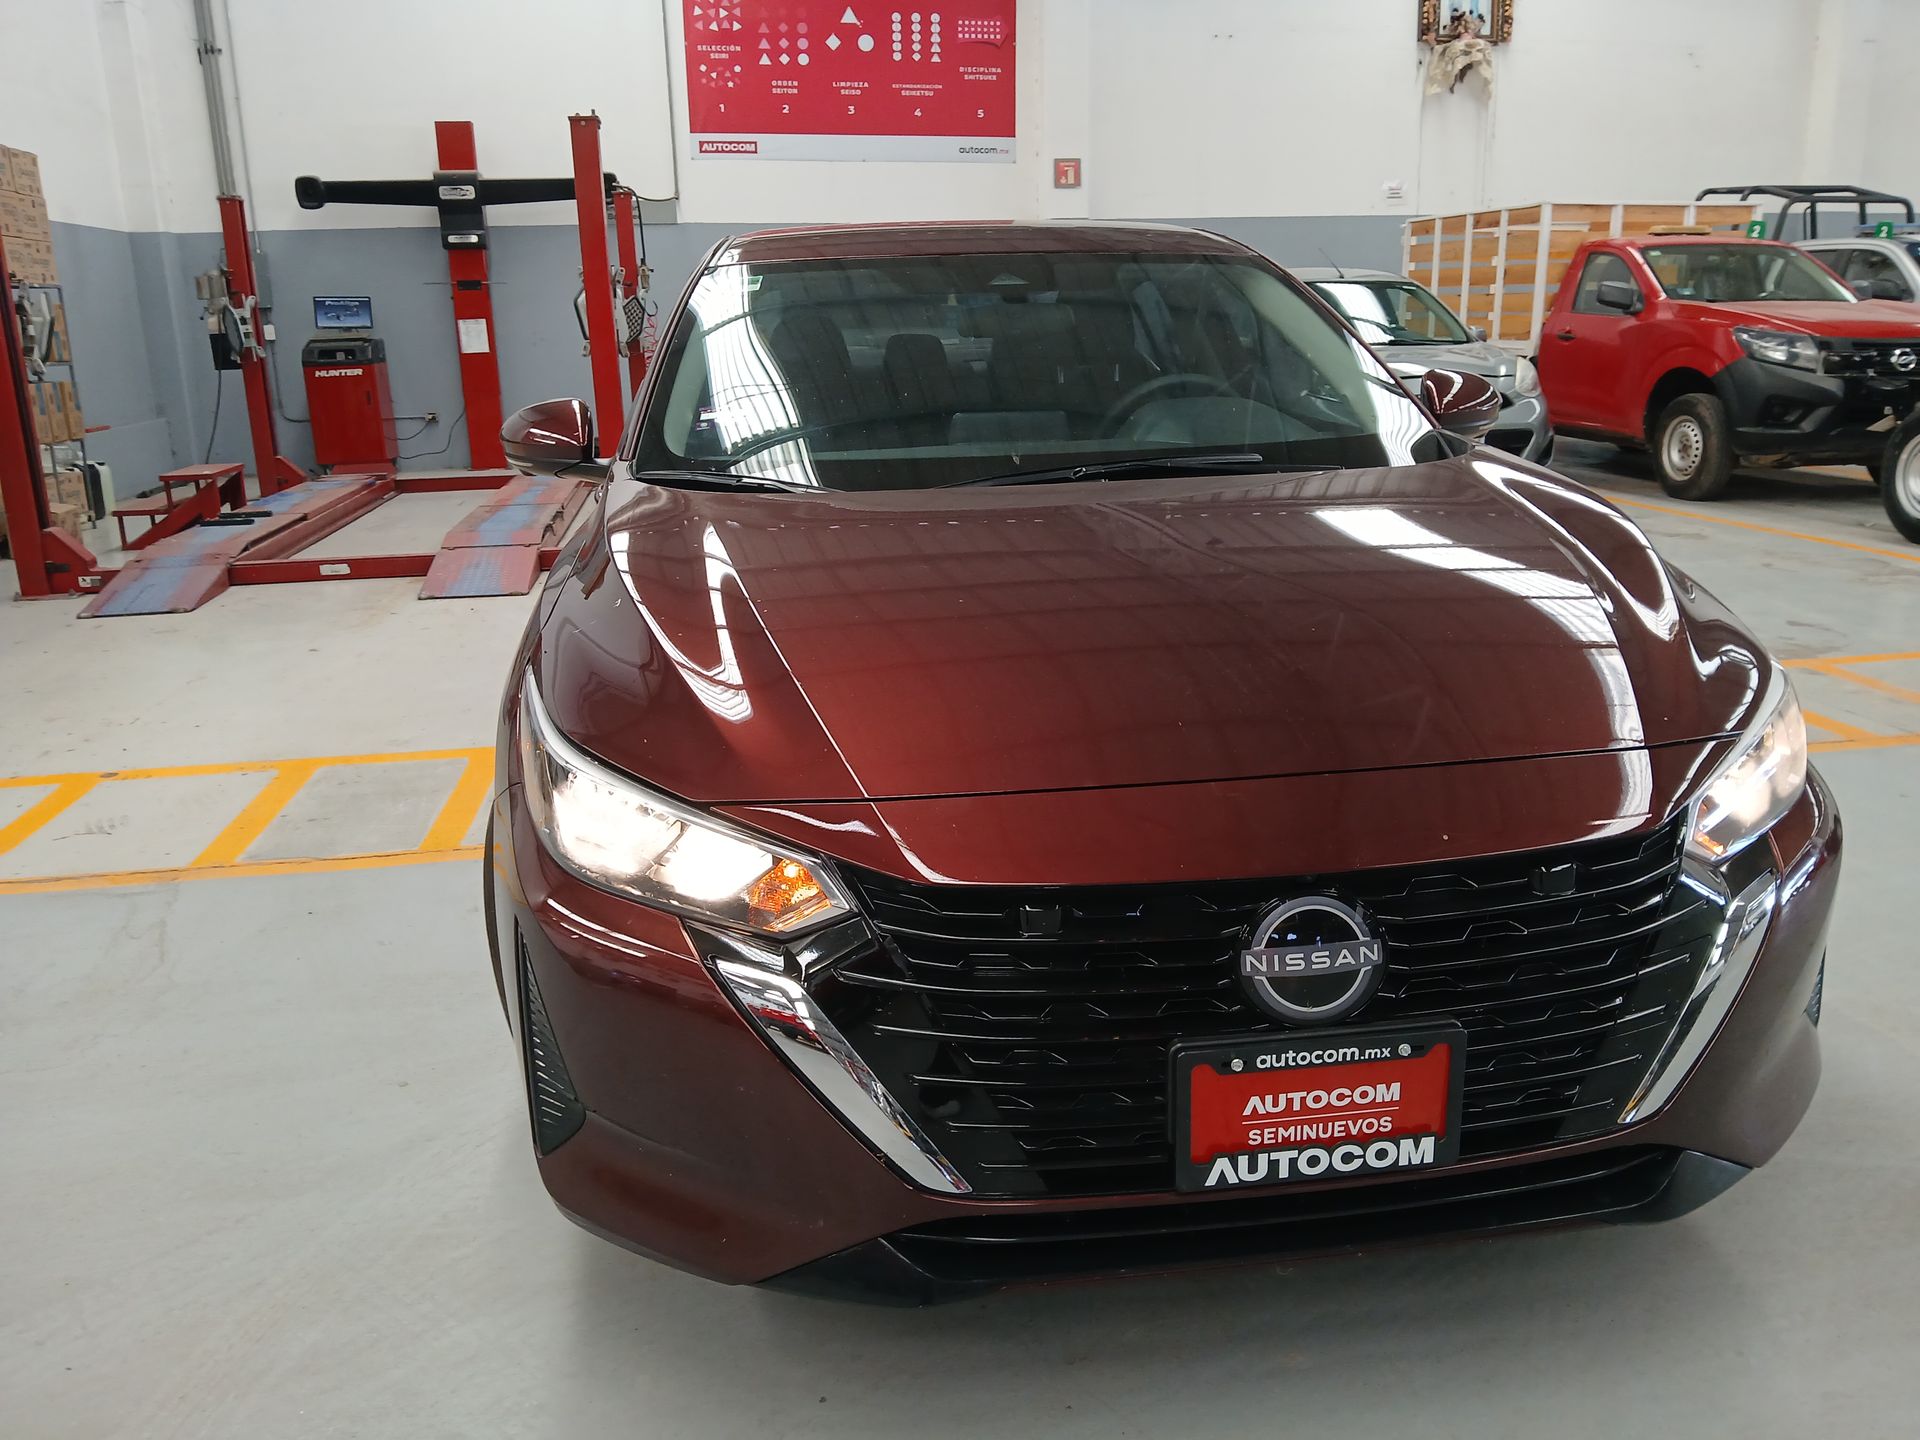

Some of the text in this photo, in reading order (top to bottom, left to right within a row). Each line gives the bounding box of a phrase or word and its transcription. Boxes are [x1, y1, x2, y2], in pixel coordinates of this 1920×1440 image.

[719, 103, 725, 112] 1
[782, 105, 790, 114] 2
[847, 106, 855, 115] 3
[914, 108, 922, 117] 4
[977, 109, 985, 118] 5
[701, 142, 756, 152] AUTOCOM
[1751, 225, 1761, 238] 2
[1879, 226, 1889, 238] 2
[315, 368, 363, 377] HUNTER
[1245, 943, 1380, 973] NISSAN
[1256, 1045, 1391, 1069] autocom.mx
[1242, 1081, 1401, 1116] AUTOCOM
[1247, 1116, 1393, 1146] SEMINUEVOS
[1204, 1136, 1435, 1187] AUTOCOM
